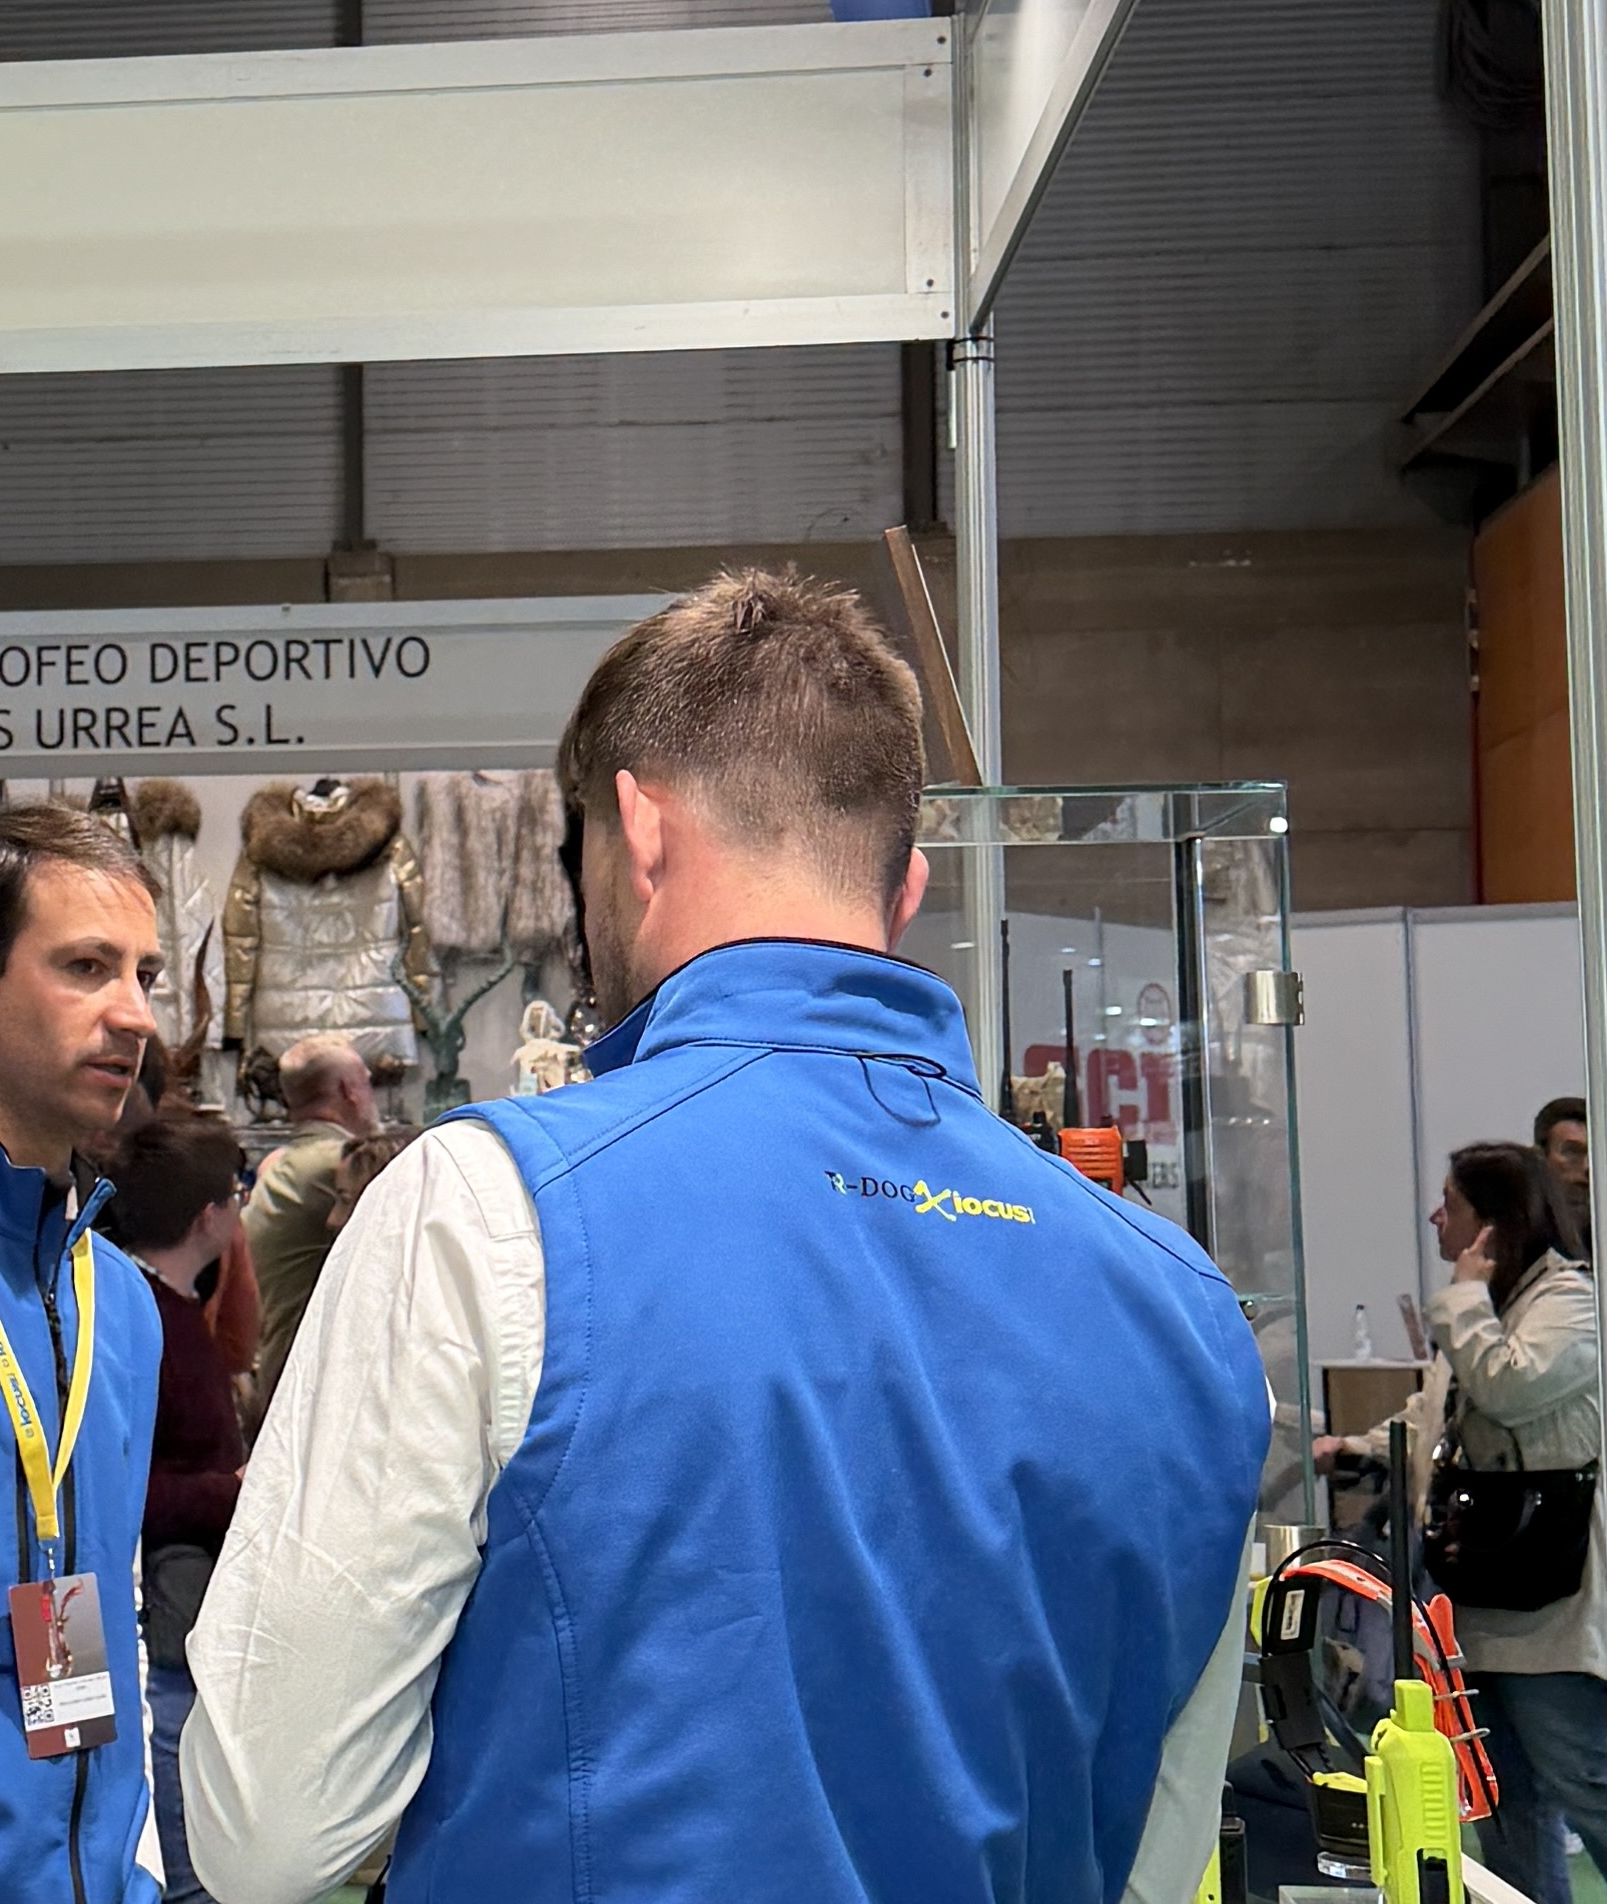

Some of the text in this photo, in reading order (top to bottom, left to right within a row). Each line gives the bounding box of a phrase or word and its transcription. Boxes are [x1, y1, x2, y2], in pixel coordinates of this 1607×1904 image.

[149, 636, 431, 684] DEPORTIVO
[36, 706, 196, 750] URREA
[215, 704, 305, 746] S.L.
